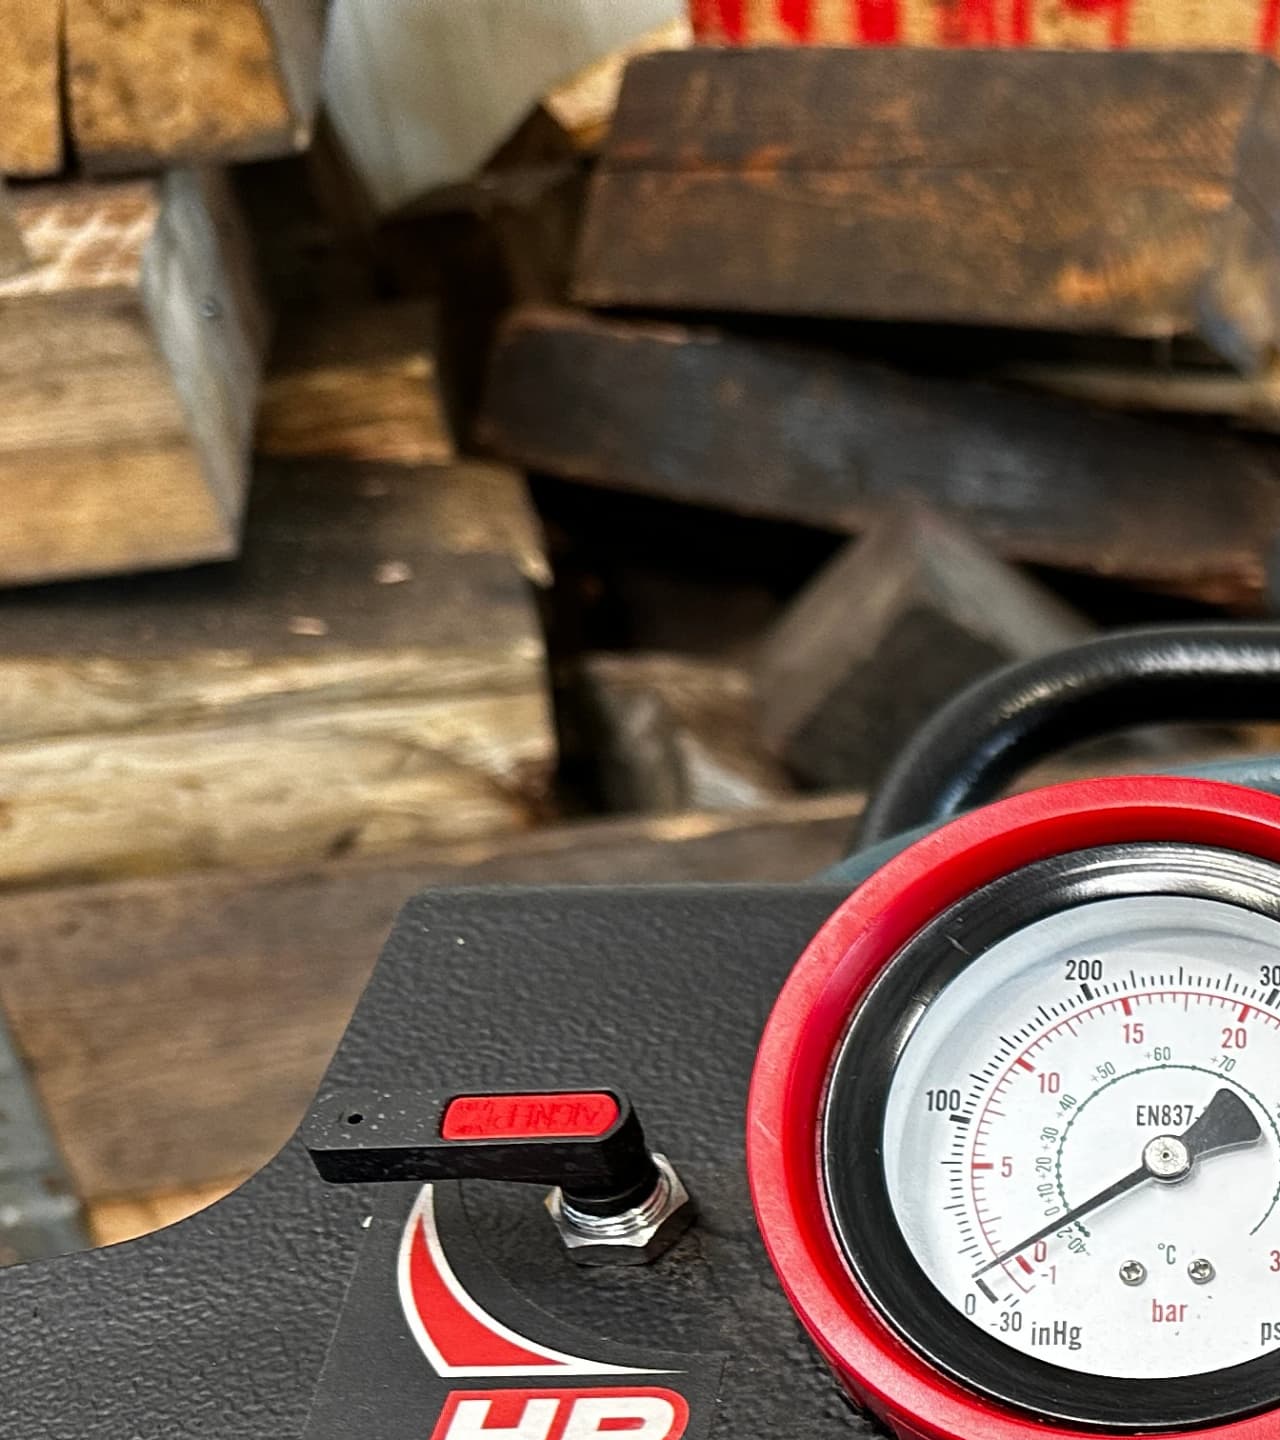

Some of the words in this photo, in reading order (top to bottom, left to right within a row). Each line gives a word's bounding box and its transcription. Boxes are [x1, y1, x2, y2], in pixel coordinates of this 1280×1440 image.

[1064, 959, 1103, 981] 200
[1122, 1023, 1144, 1044] 15
[1221, 1028, 1247, 1049] 20
[1038, 1072, 1060, 1094] 10
[926, 1089, 961, 1112] 100
[1001, 1156, 1013, 1178] 5
[1034, 1240, 1047, 1263] 0
[1041, 1265, 1057, 1285] -1
[965, 1293, 976, 1315] 0
[1152, 1298, 1188, 1323] bar
[990, 1311, 1022, 1332] -30
[1031, 1320, 1083, 1351] inHg
